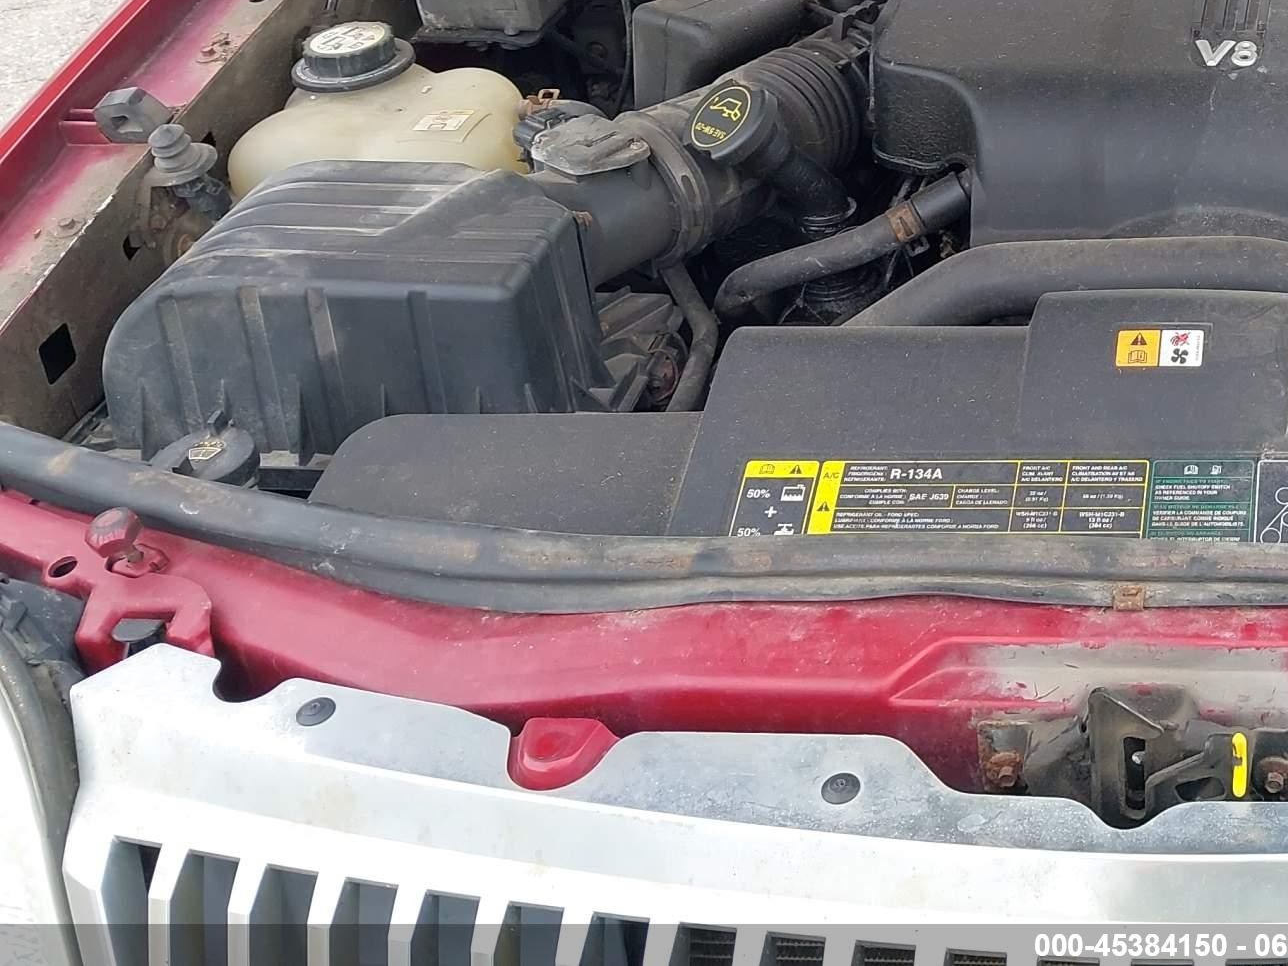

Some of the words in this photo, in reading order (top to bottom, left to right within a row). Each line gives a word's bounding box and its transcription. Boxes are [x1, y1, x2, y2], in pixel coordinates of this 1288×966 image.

[1194, 39, 1258, 66] V8
[889, 467, 943, 480] R-134A
[746, 488, 771, 499] 50%
[736, 526, 761, 538] 50%
